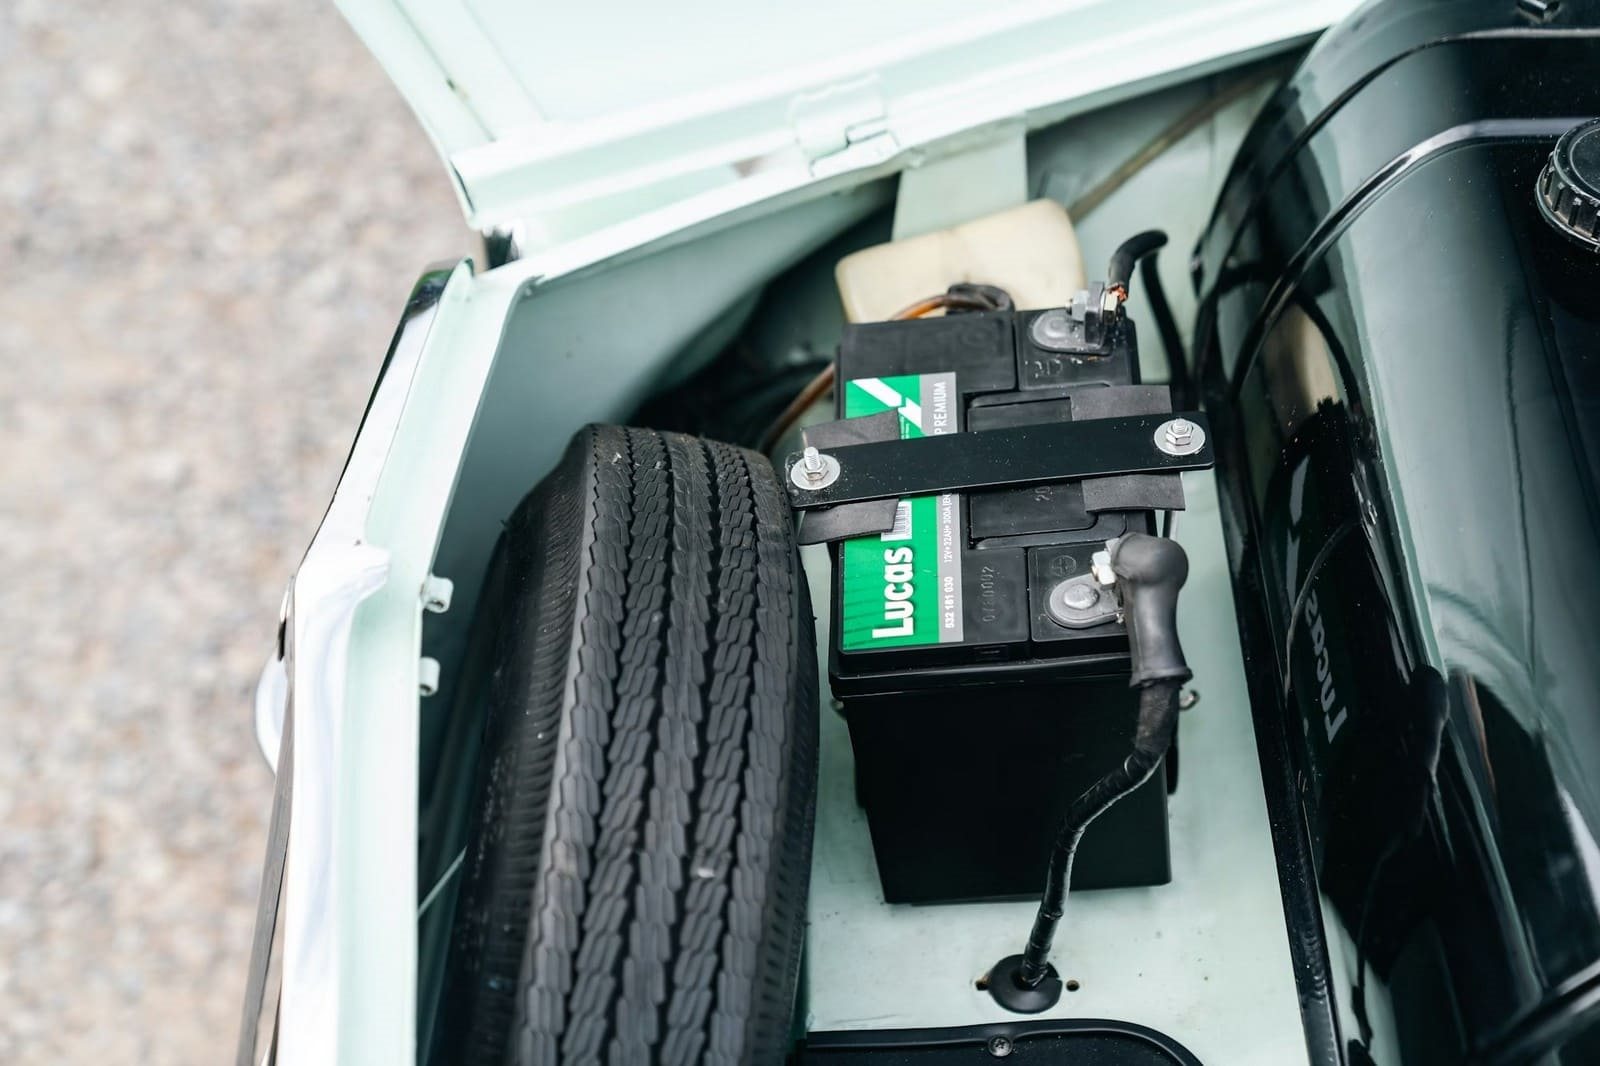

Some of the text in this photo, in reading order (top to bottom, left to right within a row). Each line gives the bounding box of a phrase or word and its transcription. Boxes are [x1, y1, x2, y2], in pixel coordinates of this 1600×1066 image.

[933, 381, 948, 434] PREMIUM
[872, 546, 914, 638] Lucas
[943, 576, 954, 593] 030
[944, 611, 955, 629] 532
